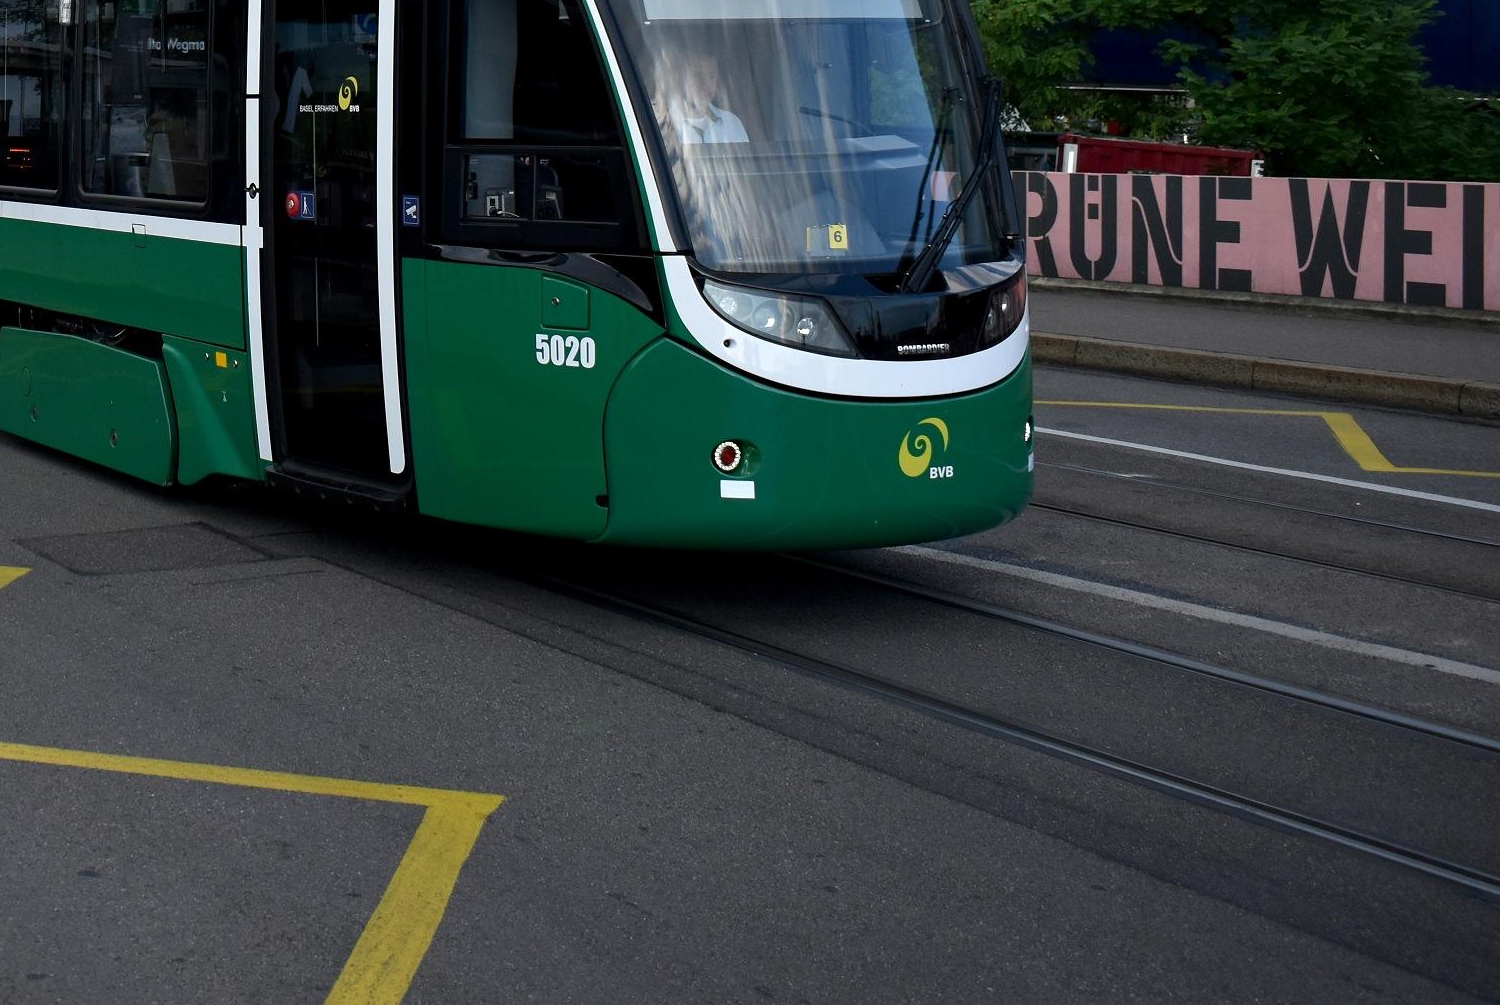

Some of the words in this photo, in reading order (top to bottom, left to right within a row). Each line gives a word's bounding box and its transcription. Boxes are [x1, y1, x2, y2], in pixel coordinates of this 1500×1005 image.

[348, 104, 360, 113] BVB
[833, 230, 843, 243] 6
[1012, 170, 1253, 293] RÜNE
[535, 333, 596, 369] 5020
[897, 343, 950, 354] BOMBARDIER
[929, 465, 954, 479] BVB
